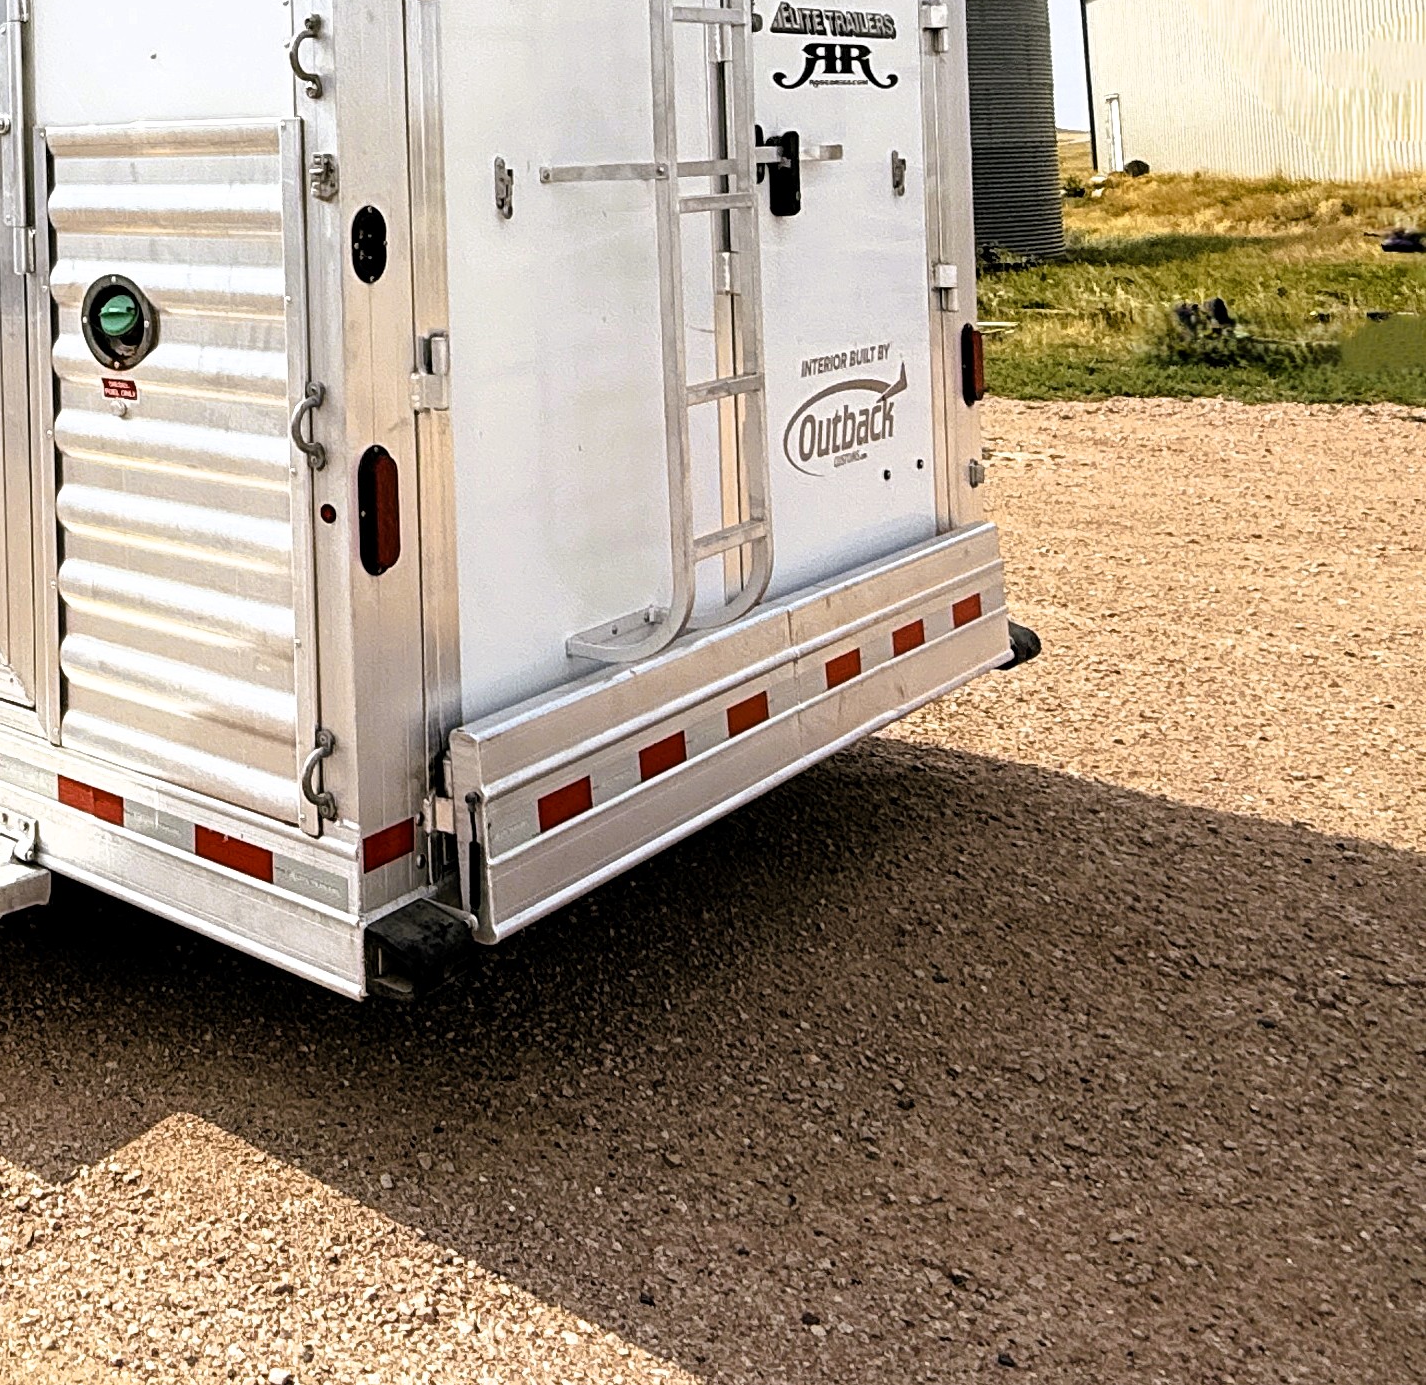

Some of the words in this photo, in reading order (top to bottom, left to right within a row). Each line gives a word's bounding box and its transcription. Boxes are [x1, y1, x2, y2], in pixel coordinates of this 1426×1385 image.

[770, 1, 827, 36] ELITE
[824, 9, 897, 40] TRAILERS
[801, 352, 847, 378] INTERIOR
[849, 345, 876, 369] BUILT
[877, 343, 890, 361] BY
[798, 398, 895, 462] Outback
